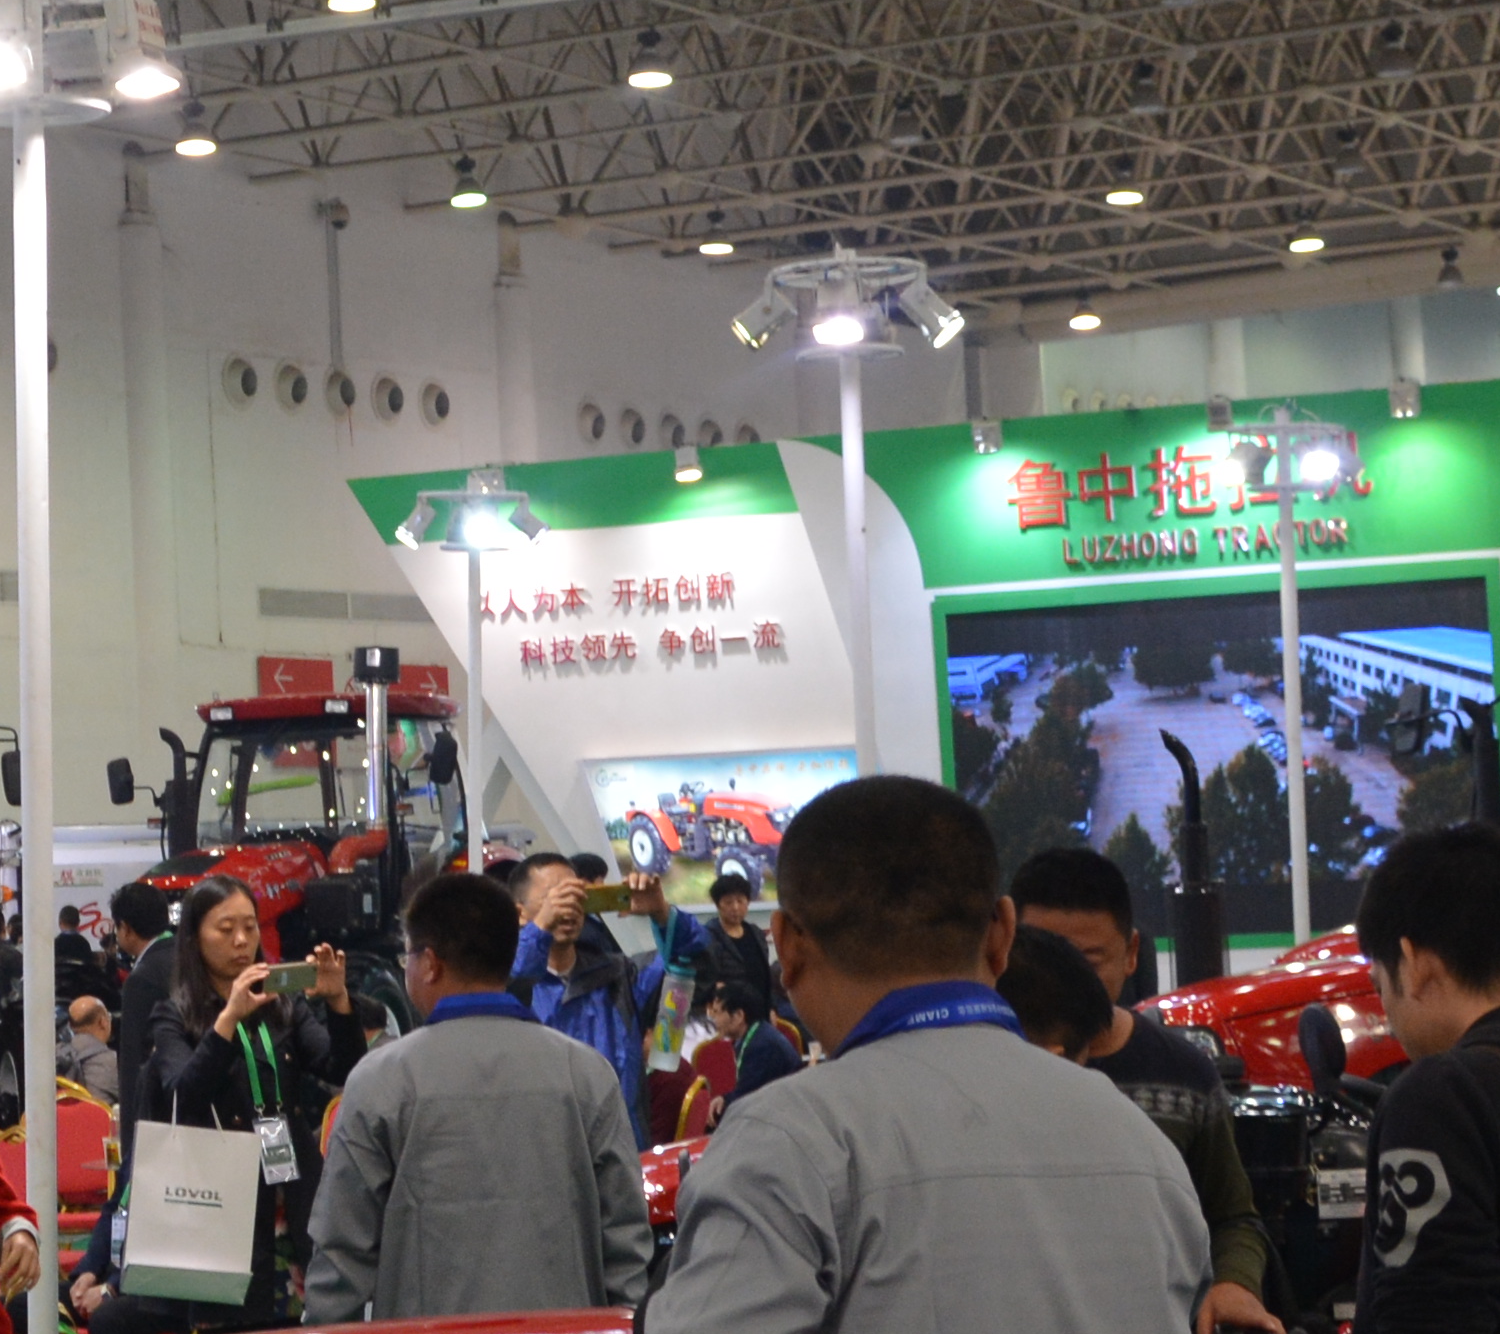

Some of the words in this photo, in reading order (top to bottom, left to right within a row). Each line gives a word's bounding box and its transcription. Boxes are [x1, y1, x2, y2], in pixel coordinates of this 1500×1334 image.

[1008, 431, 1373, 529] 鲁中拖拉
[1063, 528, 1199, 565] LUZHONG
[612, 572, 735, 607] 开拓创新
[520, 631, 637, 666] 科技领先
[659, 620, 781, 655] 争创一流
[164, 1186, 223, 1202] LOVOL
